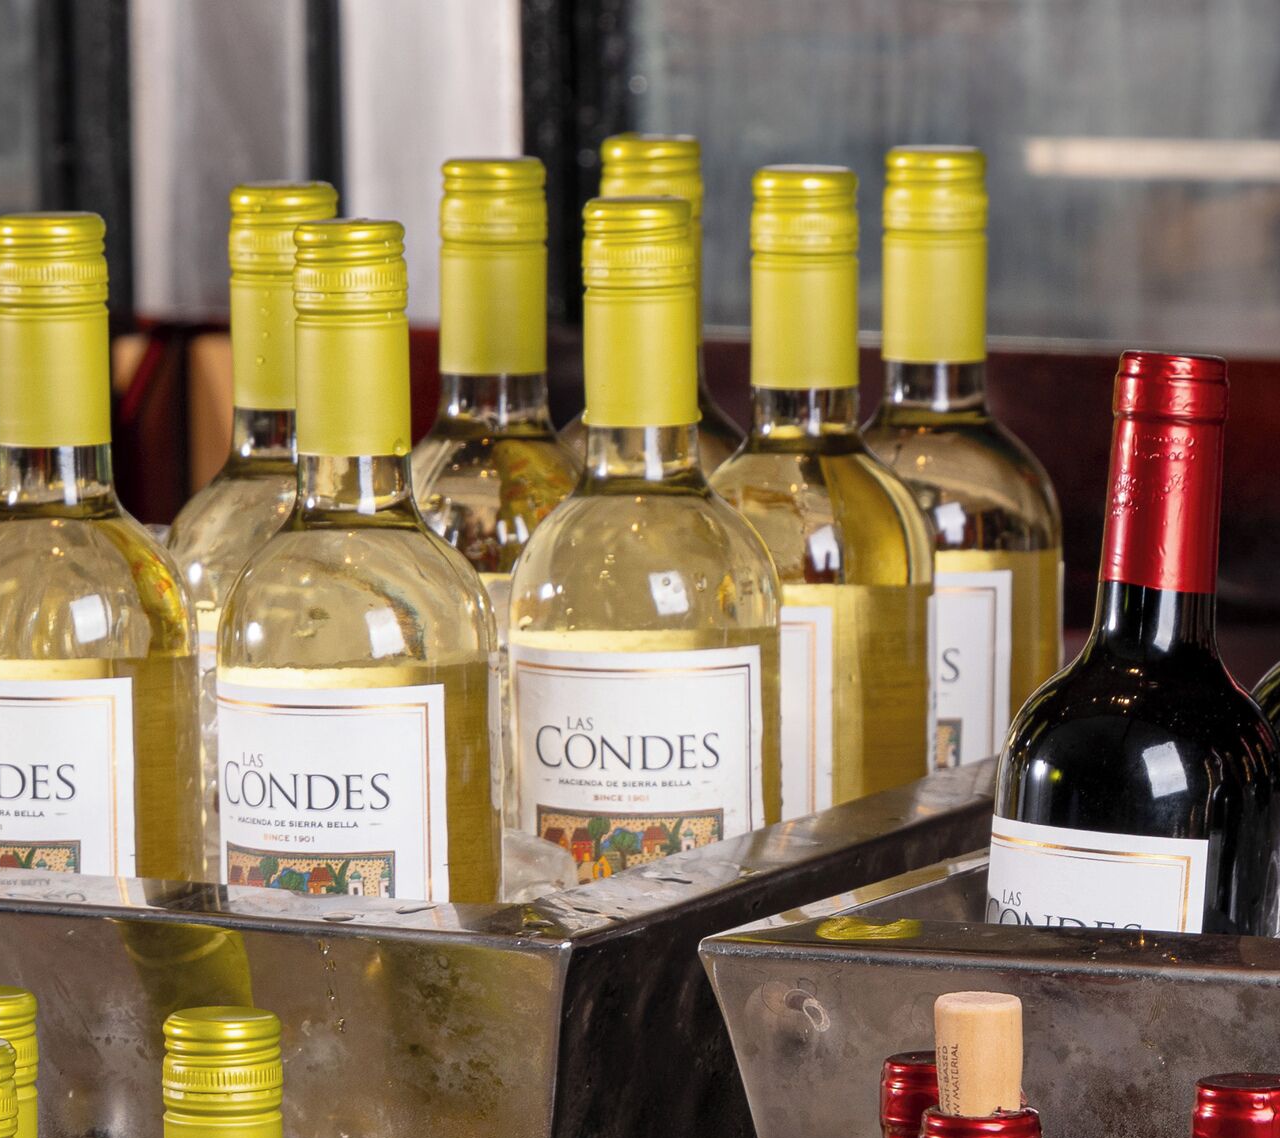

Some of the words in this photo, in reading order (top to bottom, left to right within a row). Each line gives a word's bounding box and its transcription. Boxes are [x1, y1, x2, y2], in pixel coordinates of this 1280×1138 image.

[567, 716, 594, 730] LAS
[536, 725, 720, 771] CONDES
[242, 751, 264, 768] LAS
[224, 761, 390, 811] CONDES
[558, 778, 603, 787] HACIENDA
[606, 780, 618, 788] DE
[622, 780, 657, 788] SIERRA
[661, 780, 692, 788] BELLA
[593, 794, 623, 802] SINCE
[14, 810, 45, 818] BELLA
[238, 816, 272, 827] HACIENDA
[274, 820, 286, 828] DE
[289, 820, 324, 829] SIERRA
[327, 820, 359, 829] BELLA
[293, 834, 316, 843] 1901
[1002, 889, 1022, 906] LAS
[942, 1046, 950, 1112] ANT-BASED
[951, 1044, 959, 1100] MATERIAL
